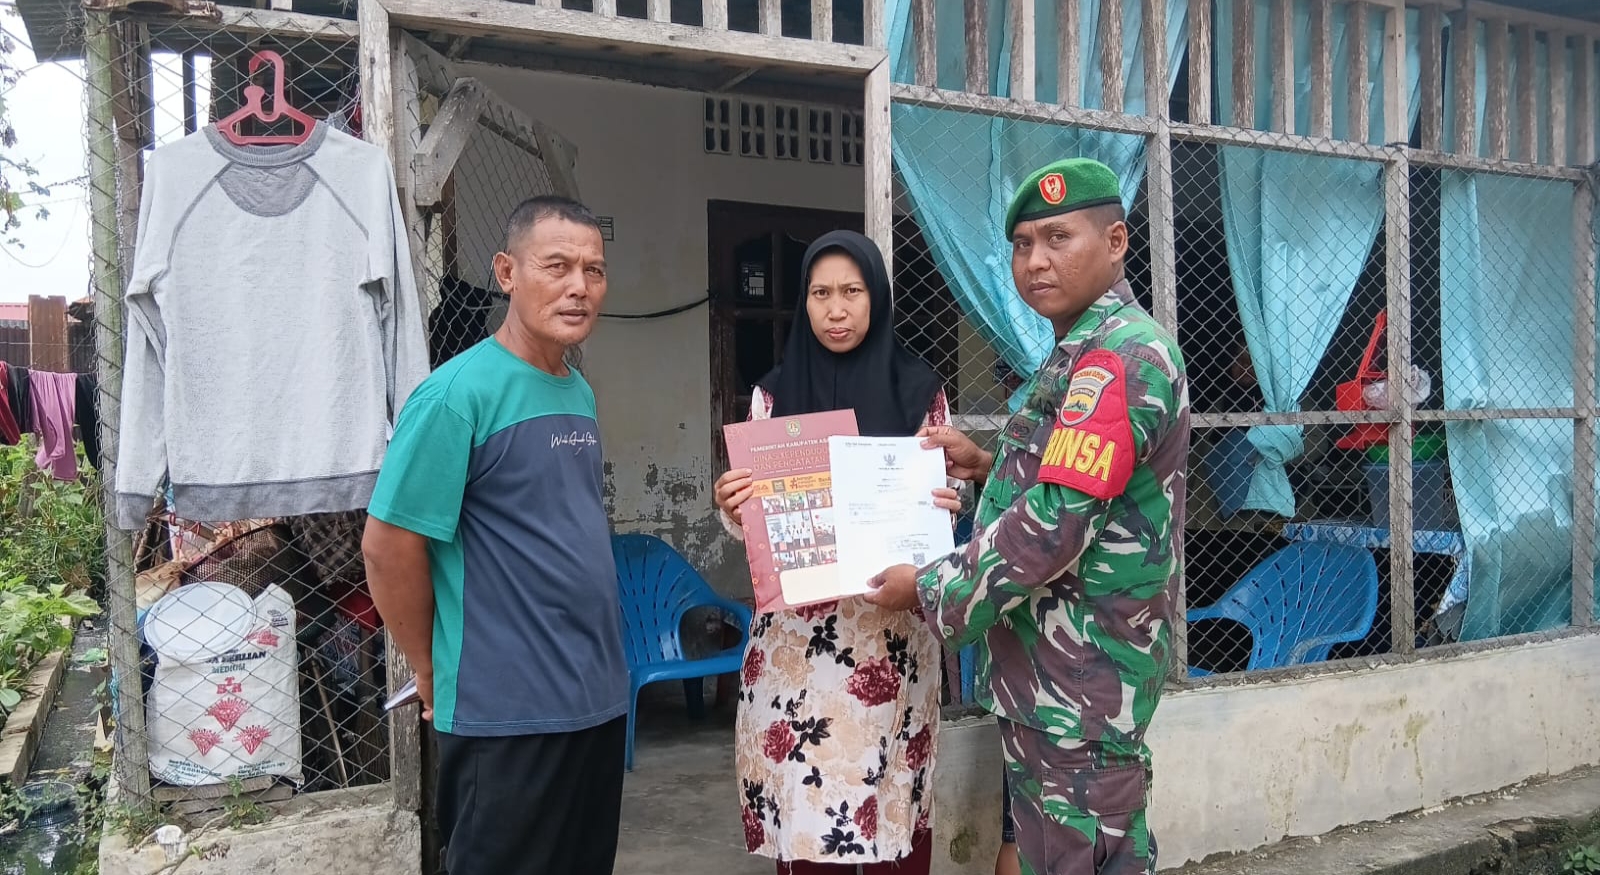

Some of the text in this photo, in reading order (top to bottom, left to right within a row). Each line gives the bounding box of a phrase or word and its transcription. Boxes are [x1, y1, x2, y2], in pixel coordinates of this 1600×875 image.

[750, 442, 786, 453] PEMERINTAH
[786, 438, 818, 448] KABUPATEN
[753, 452, 777, 463] DINAS
[753, 462, 771, 472] DAN
[774, 455, 825, 468] PENCATATAN
[221, 650, 267, 663] BERLIAN
[212, 662, 246, 674] MEDIUM
